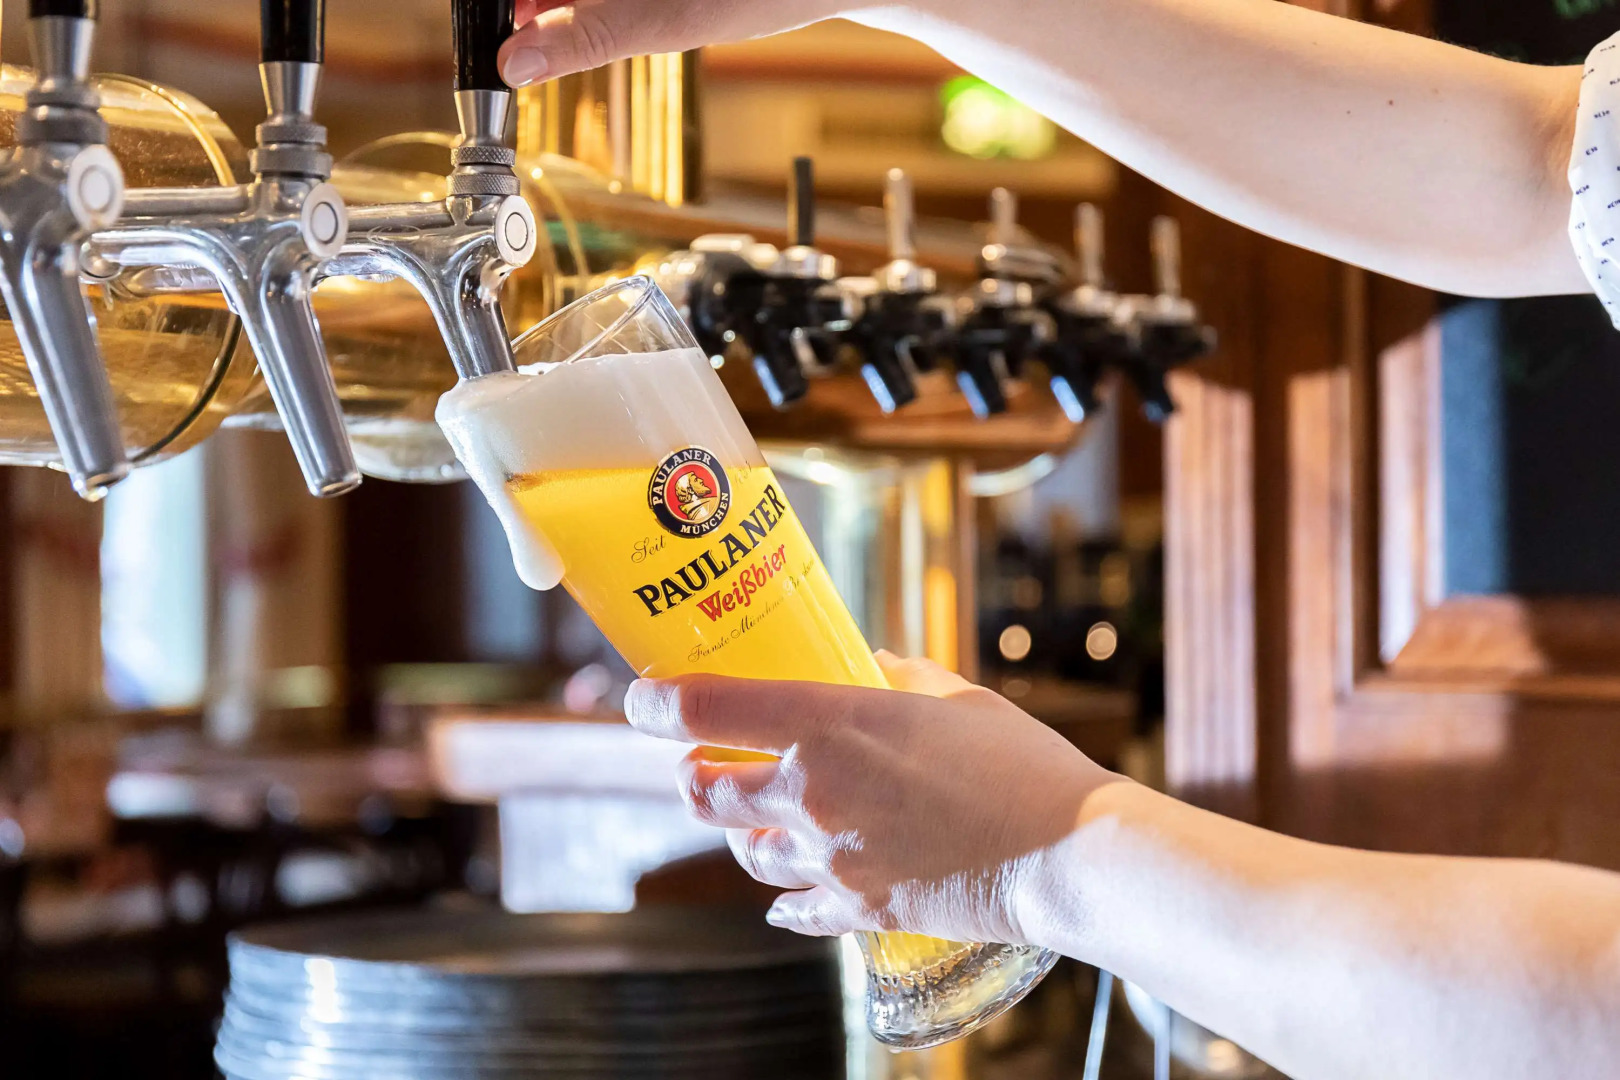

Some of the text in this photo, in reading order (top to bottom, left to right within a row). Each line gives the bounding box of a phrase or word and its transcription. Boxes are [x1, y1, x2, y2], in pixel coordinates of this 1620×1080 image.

[652, 449, 712, 505] PAULANER
[680, 492, 729, 534] MÜNCHEN
[631, 534, 666, 563] Seit
[632, 484, 786, 618] PAULANER
[696, 543, 787, 622] Weißbier
